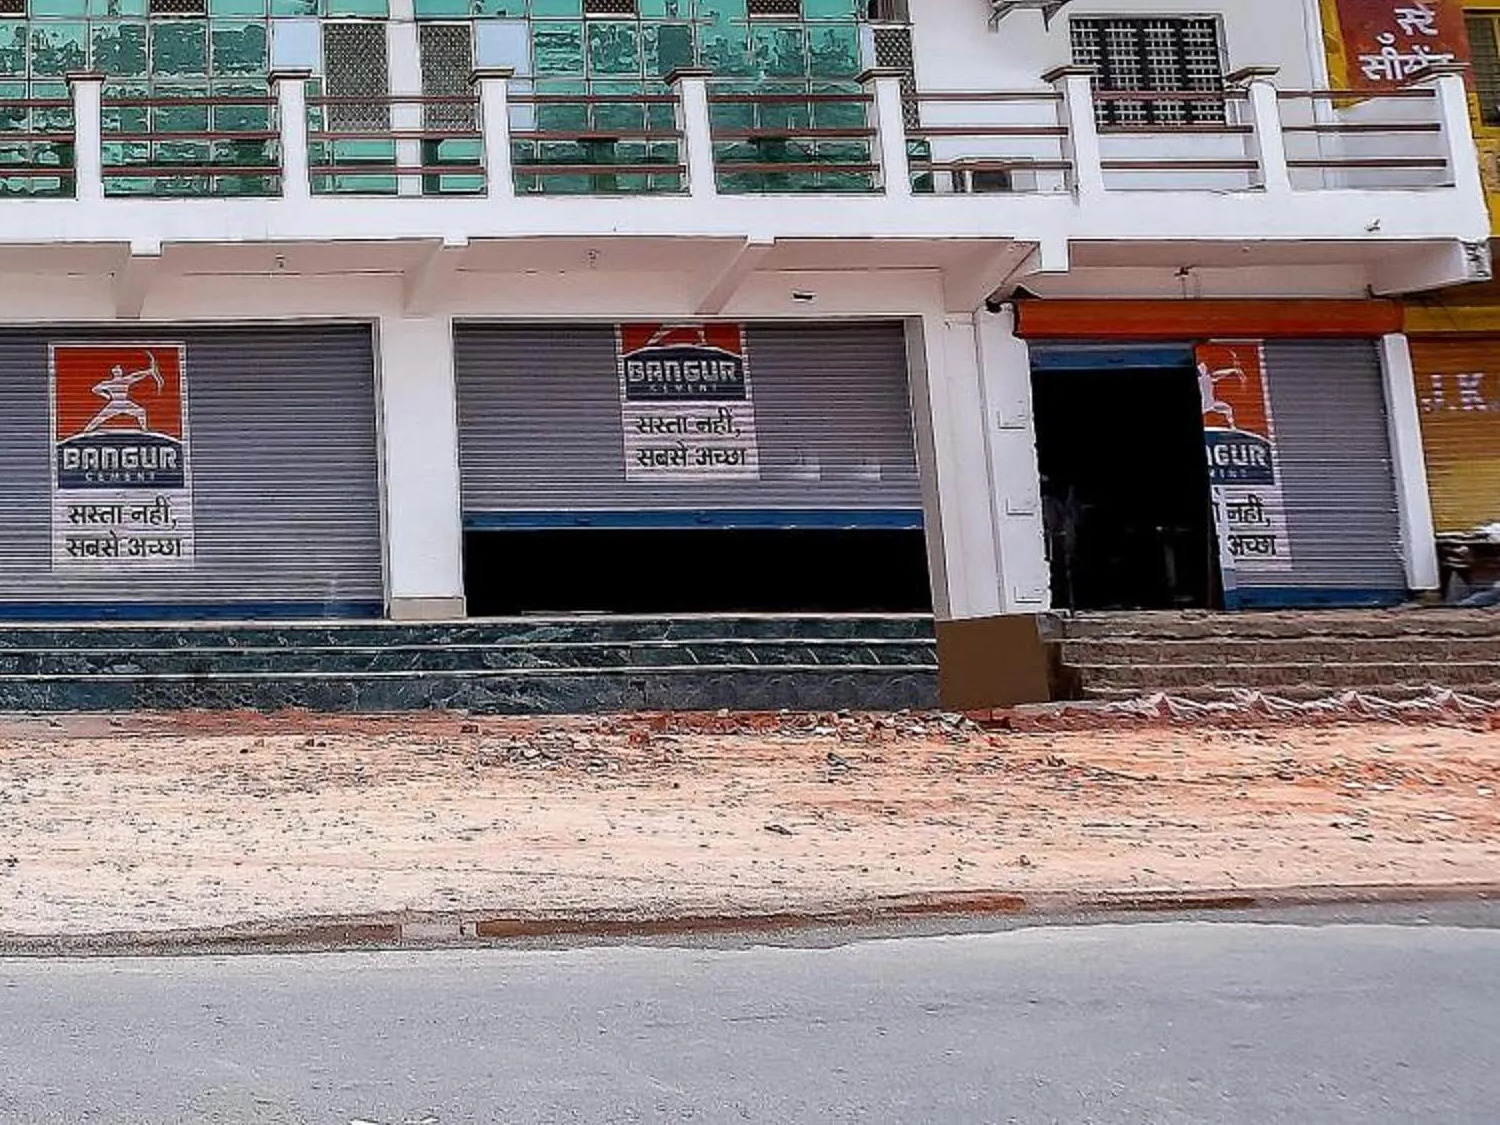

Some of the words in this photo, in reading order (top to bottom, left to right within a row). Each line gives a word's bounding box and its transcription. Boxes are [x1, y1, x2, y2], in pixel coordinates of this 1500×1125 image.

[627, 360, 738, 382] BANGUR
[636, 416, 688, 435] सस्ता
[63, 447, 177, 470] BANGUR
[636, 439, 689, 467] सबसे
[695, 448, 747, 466] अच्छा
[1205, 443, 1268, 466] GUR
[85, 472, 156, 482] CEMENT
[68, 503, 122, 525] सस्ता
[66, 530, 120, 557] सबसे
[127, 536, 182, 557] अच्छा
[1227, 534, 1277, 557] अच्छा
